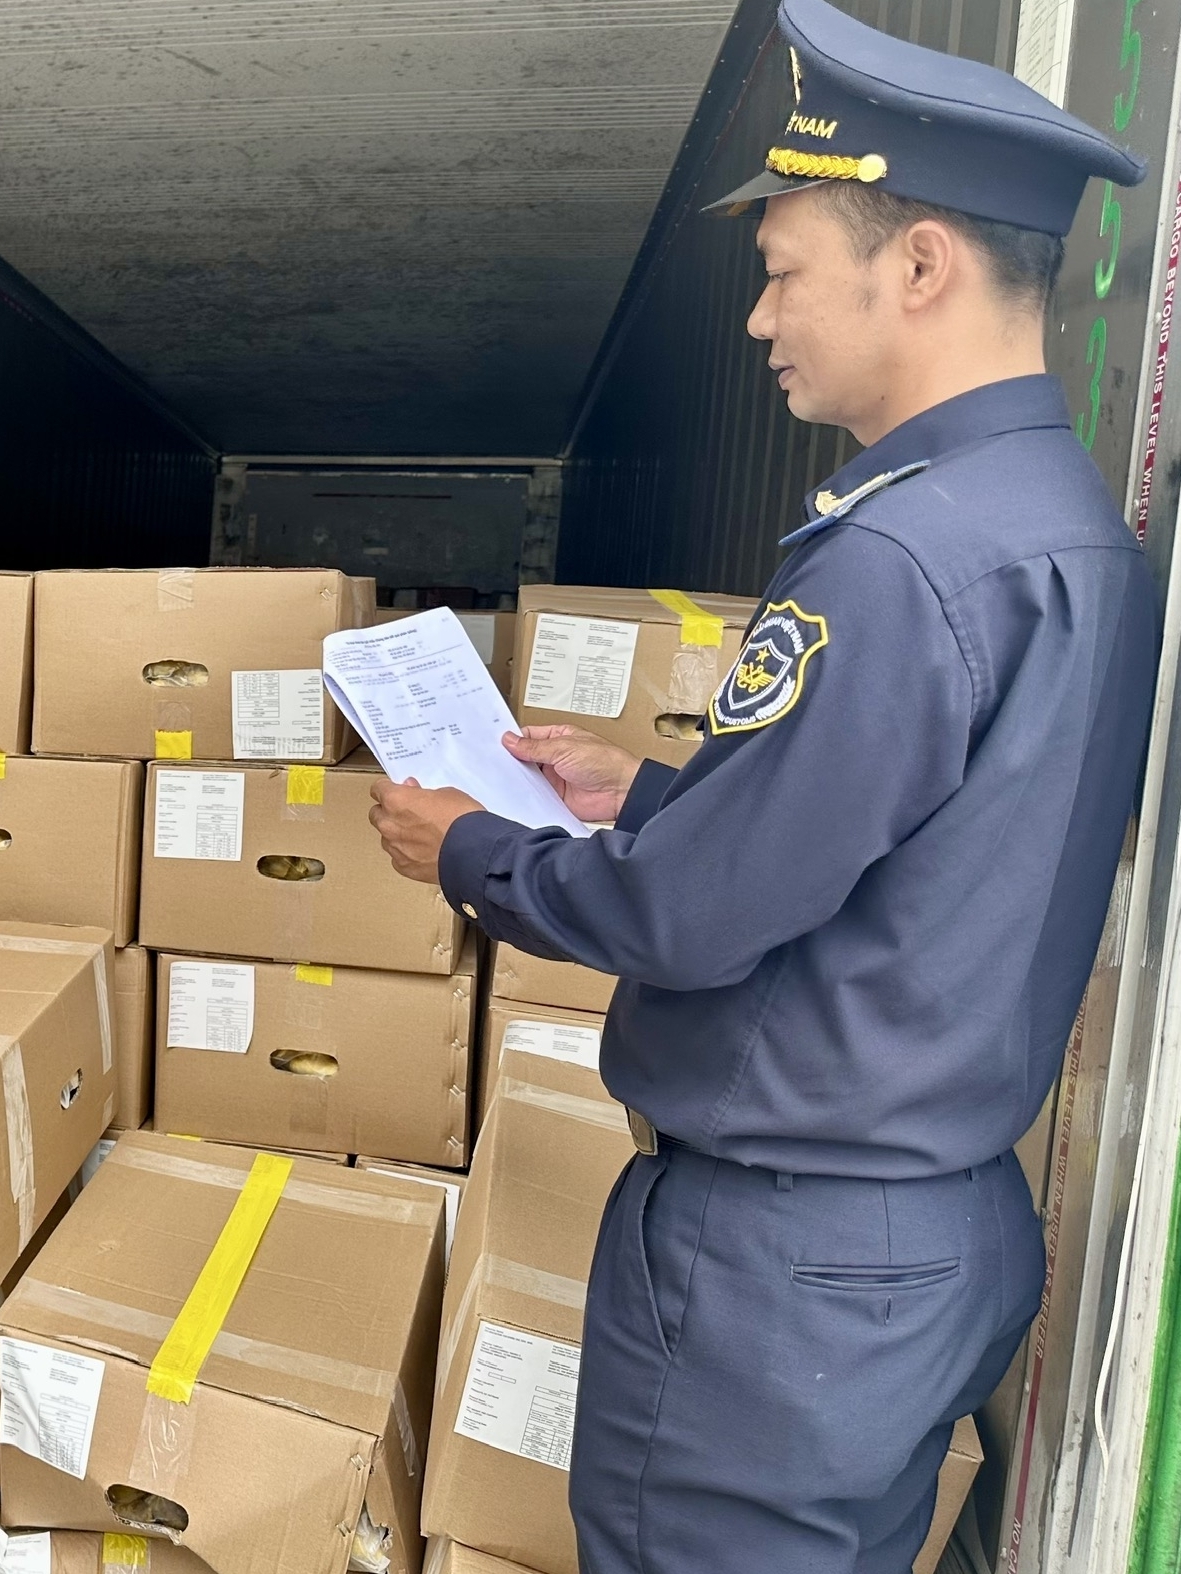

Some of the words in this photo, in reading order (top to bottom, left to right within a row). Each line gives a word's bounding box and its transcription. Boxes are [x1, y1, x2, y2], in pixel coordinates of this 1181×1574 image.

[1169, 192, 1181, 259] CARGO
[1159, 266, 1177, 344] BEYOND
[1153, 351, 1168, 394] THIS
[1145, 401, 1160, 460] LEVEL
[1137, 467, 1153, 521] WHEN
[1069, 1049, 1081, 1086] THIS
[1061, 1094, 1074, 1144] LEVEL
[1053, 1155, 1067, 1206] WHEN
[1048, 1211, 1060, 1257] USED
[1044, 1264, 1053, 1288] AS
[1035, 1293, 1050, 1360] REEFER
[1012, 1517, 1022, 1545] NO
